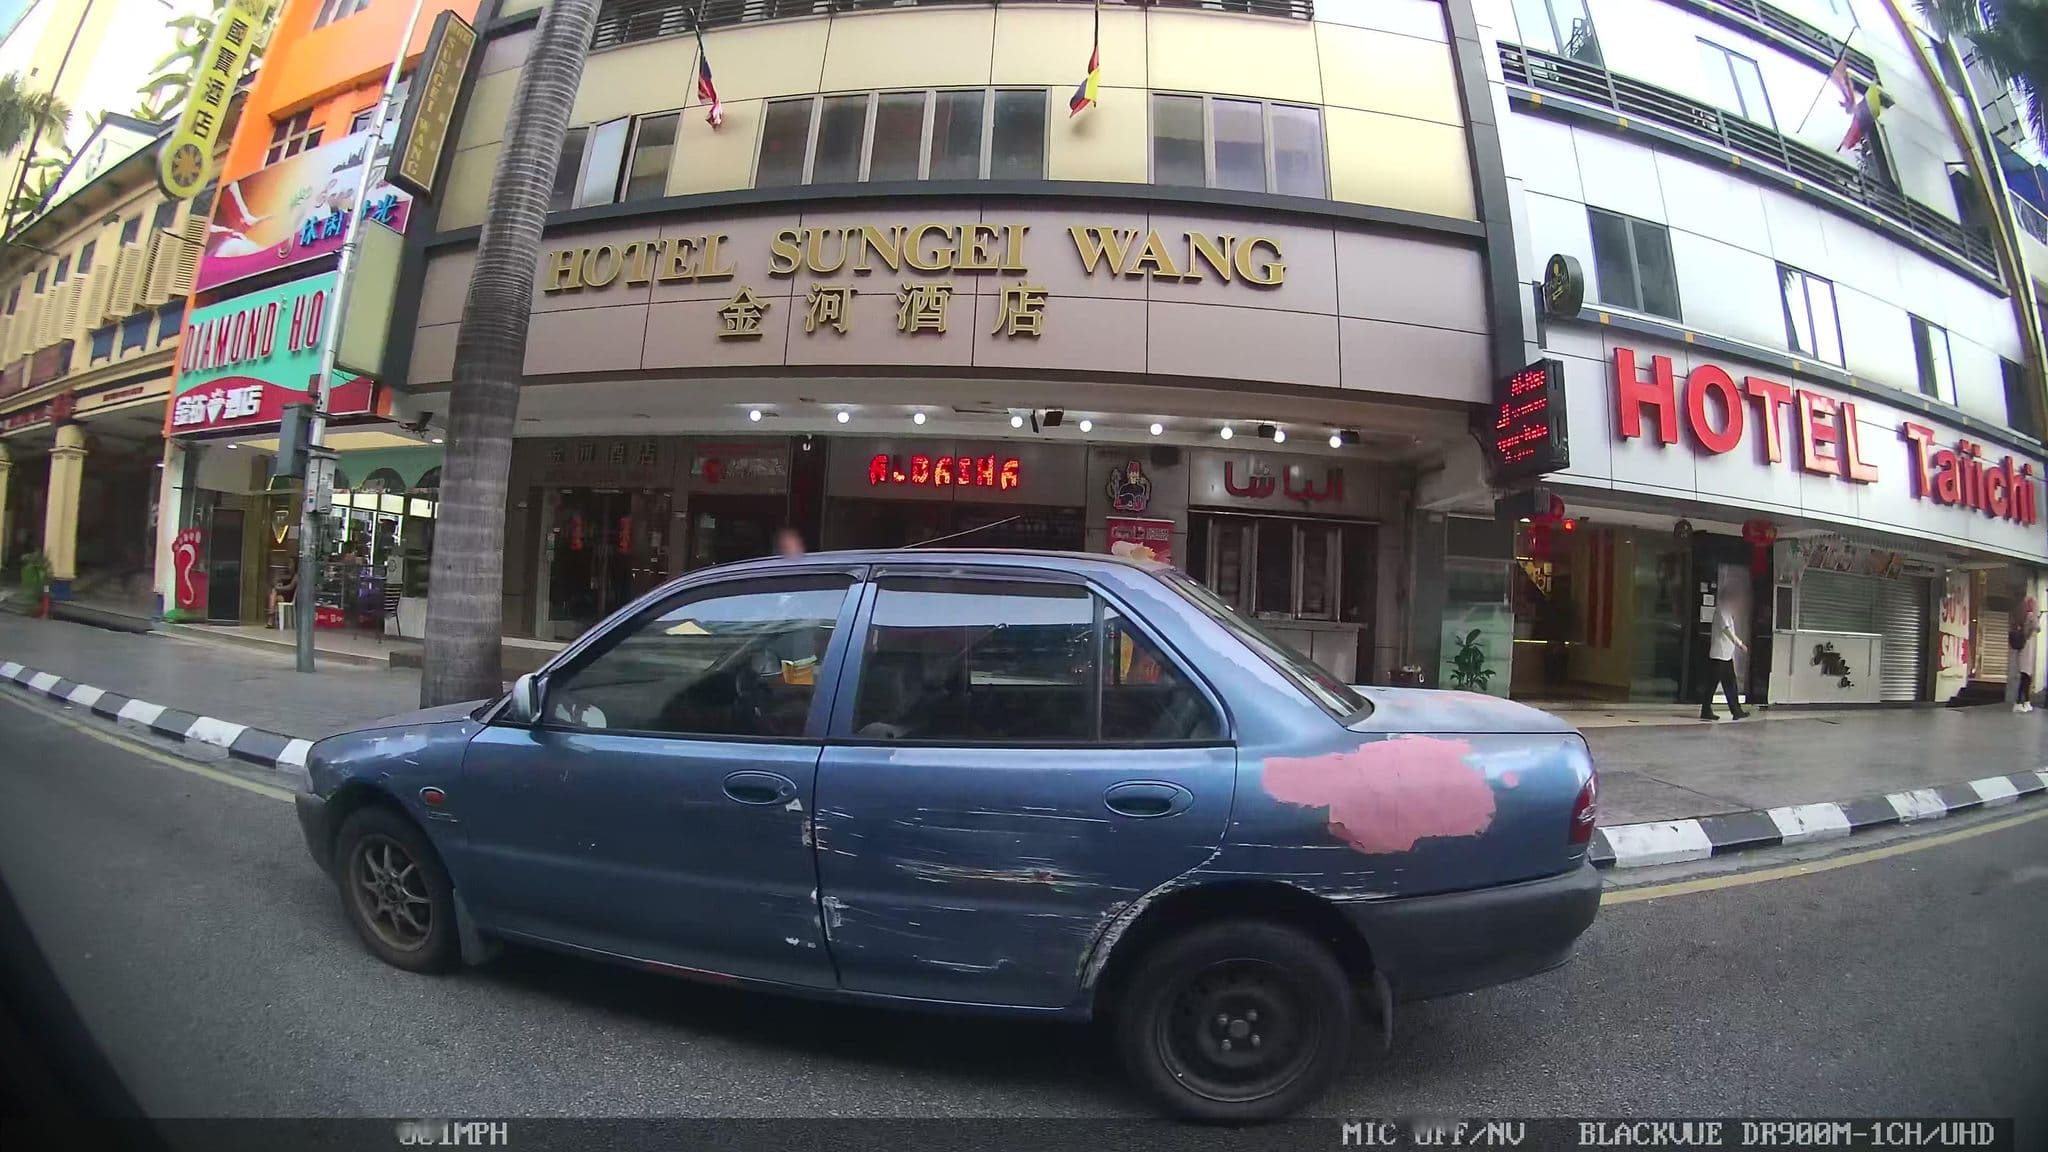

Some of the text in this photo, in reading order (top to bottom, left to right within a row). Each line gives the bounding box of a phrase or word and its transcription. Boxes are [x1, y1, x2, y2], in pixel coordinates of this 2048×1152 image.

[300, 192, 398, 247] 休闲光
[544, 223, 1288, 293] HOTEL SUNGEI WANG
[182, 289, 334, 375] DIAMOND HO
[716, 280, 1048, 342] 金河酒店
[1614, 347, 2037, 526] HOTEL Taiichi
[868, 453, 1020, 490] ALBASHA
